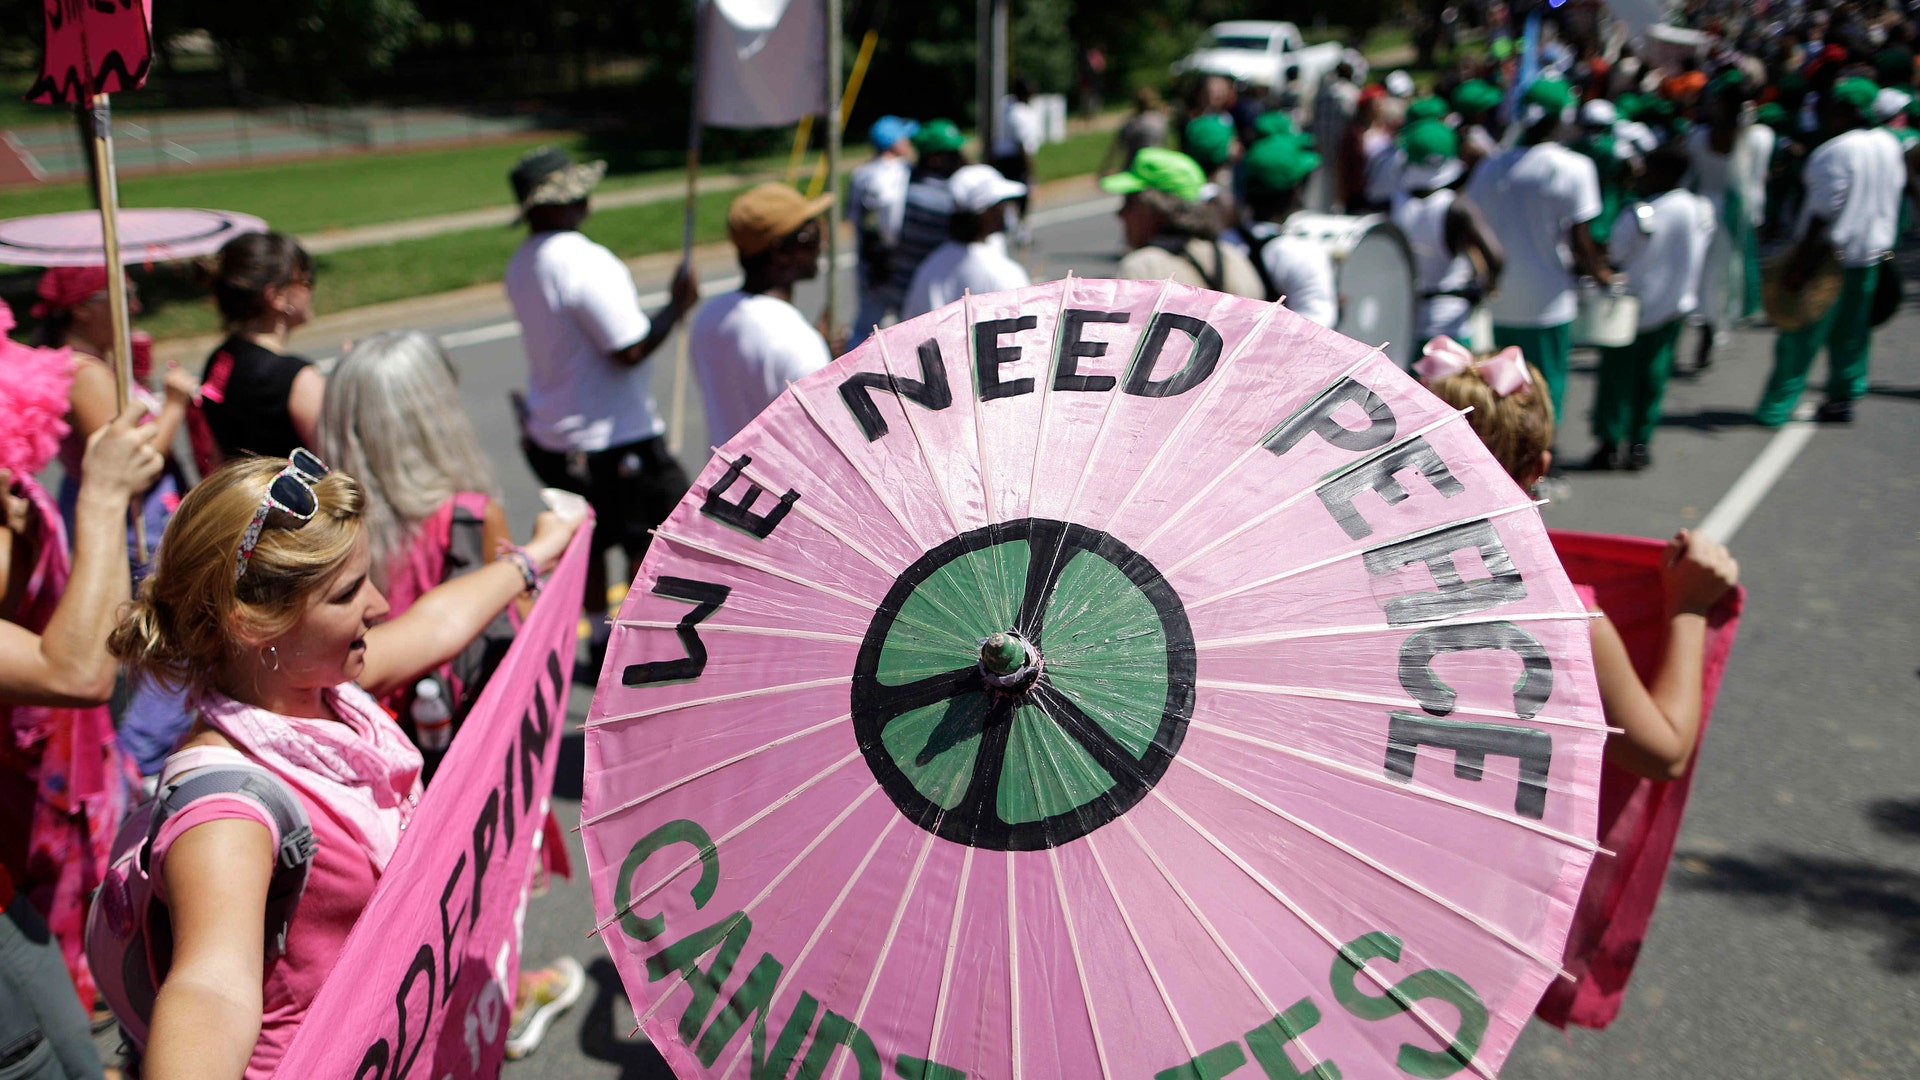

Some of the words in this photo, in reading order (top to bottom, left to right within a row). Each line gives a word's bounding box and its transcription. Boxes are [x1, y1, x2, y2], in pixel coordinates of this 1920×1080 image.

[622, 454, 801, 688] WE
[837, 309, 1223, 442] NEED
[1262, 376, 1553, 820] PEACE
